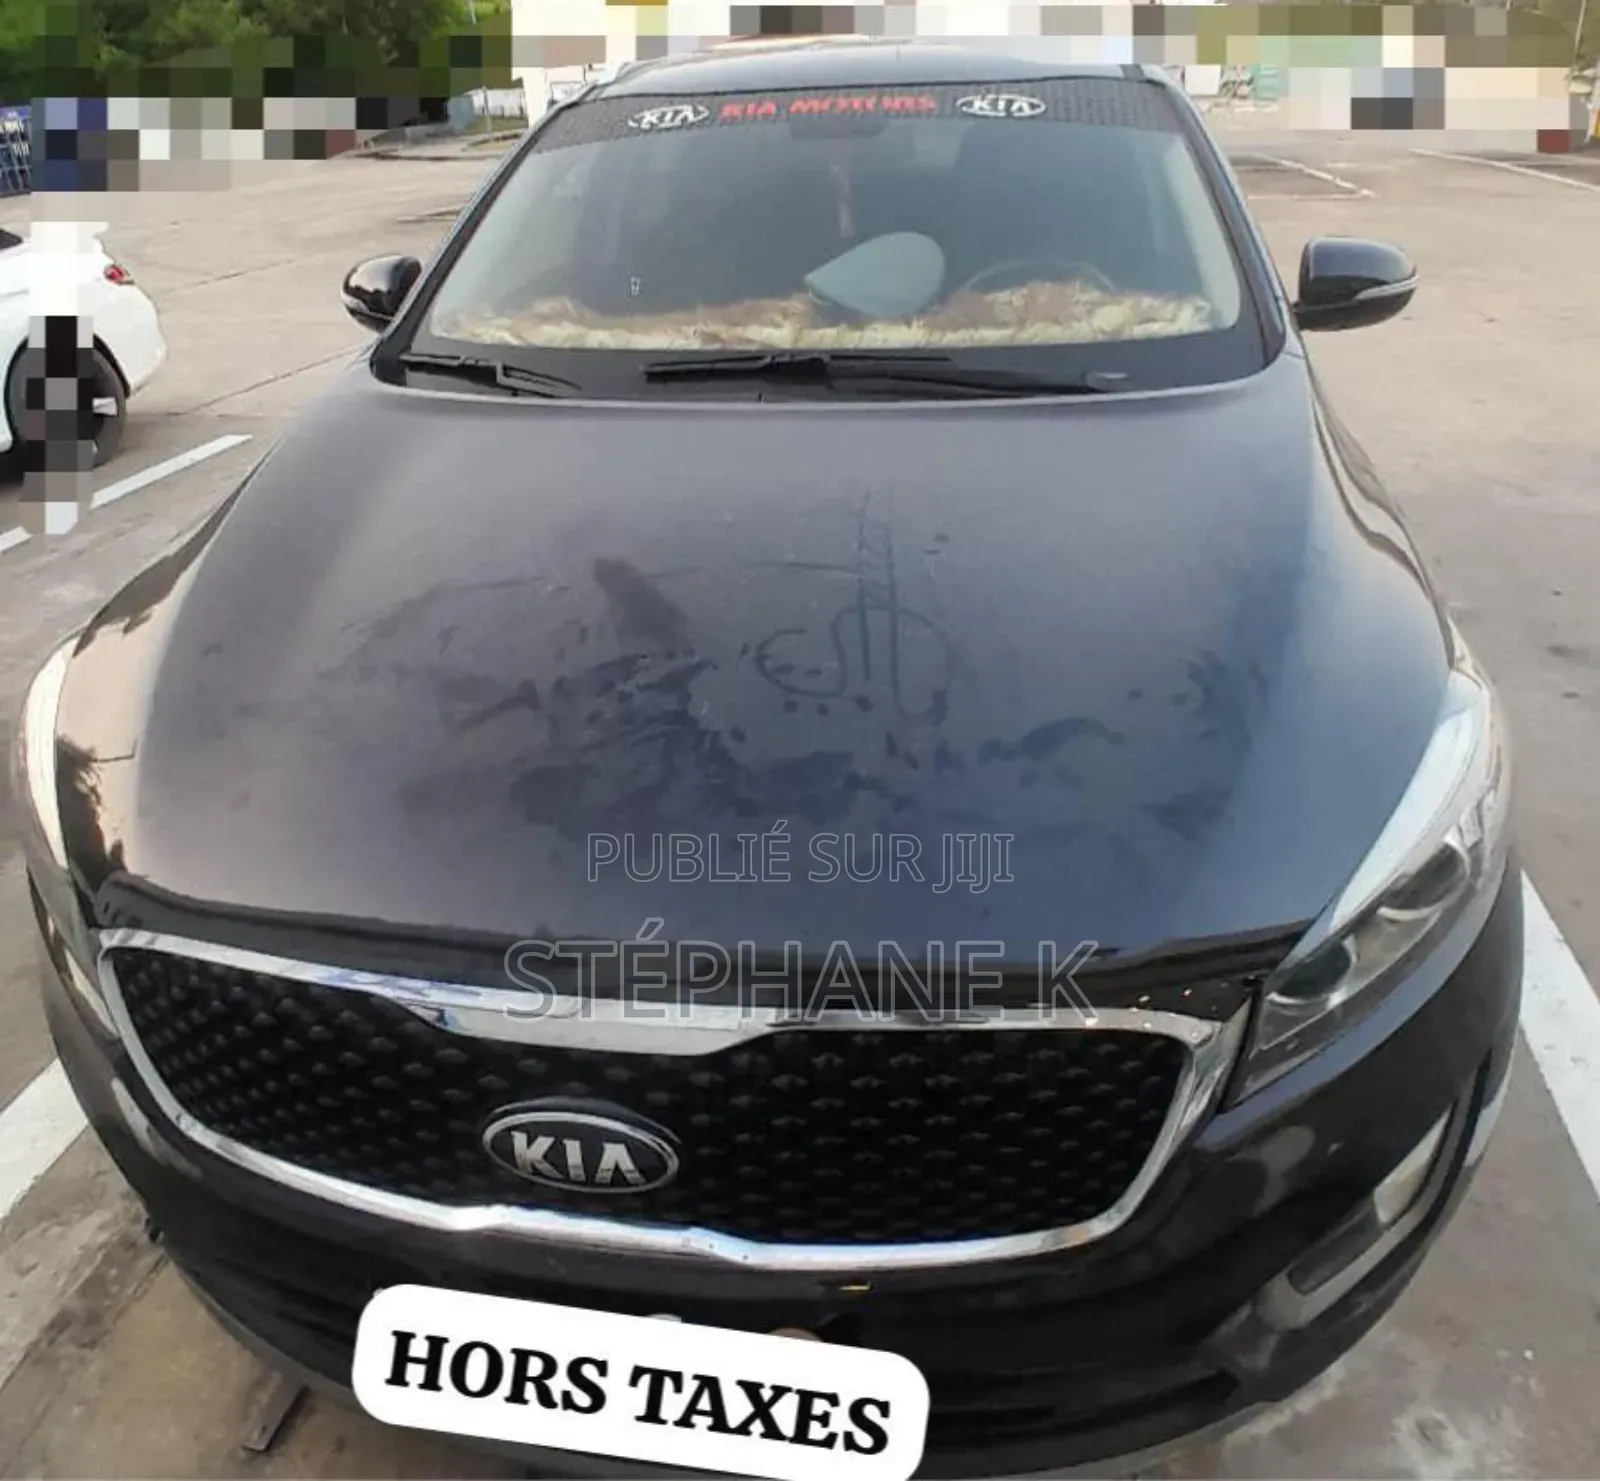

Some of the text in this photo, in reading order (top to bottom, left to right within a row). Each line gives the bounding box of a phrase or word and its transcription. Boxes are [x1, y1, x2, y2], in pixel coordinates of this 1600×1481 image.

[720, 102, 776, 118] KIA
[972, 96, 1031, 115] KIA
[640, 105, 695, 129] KIA
[511, 1131, 647, 1185] KIA
